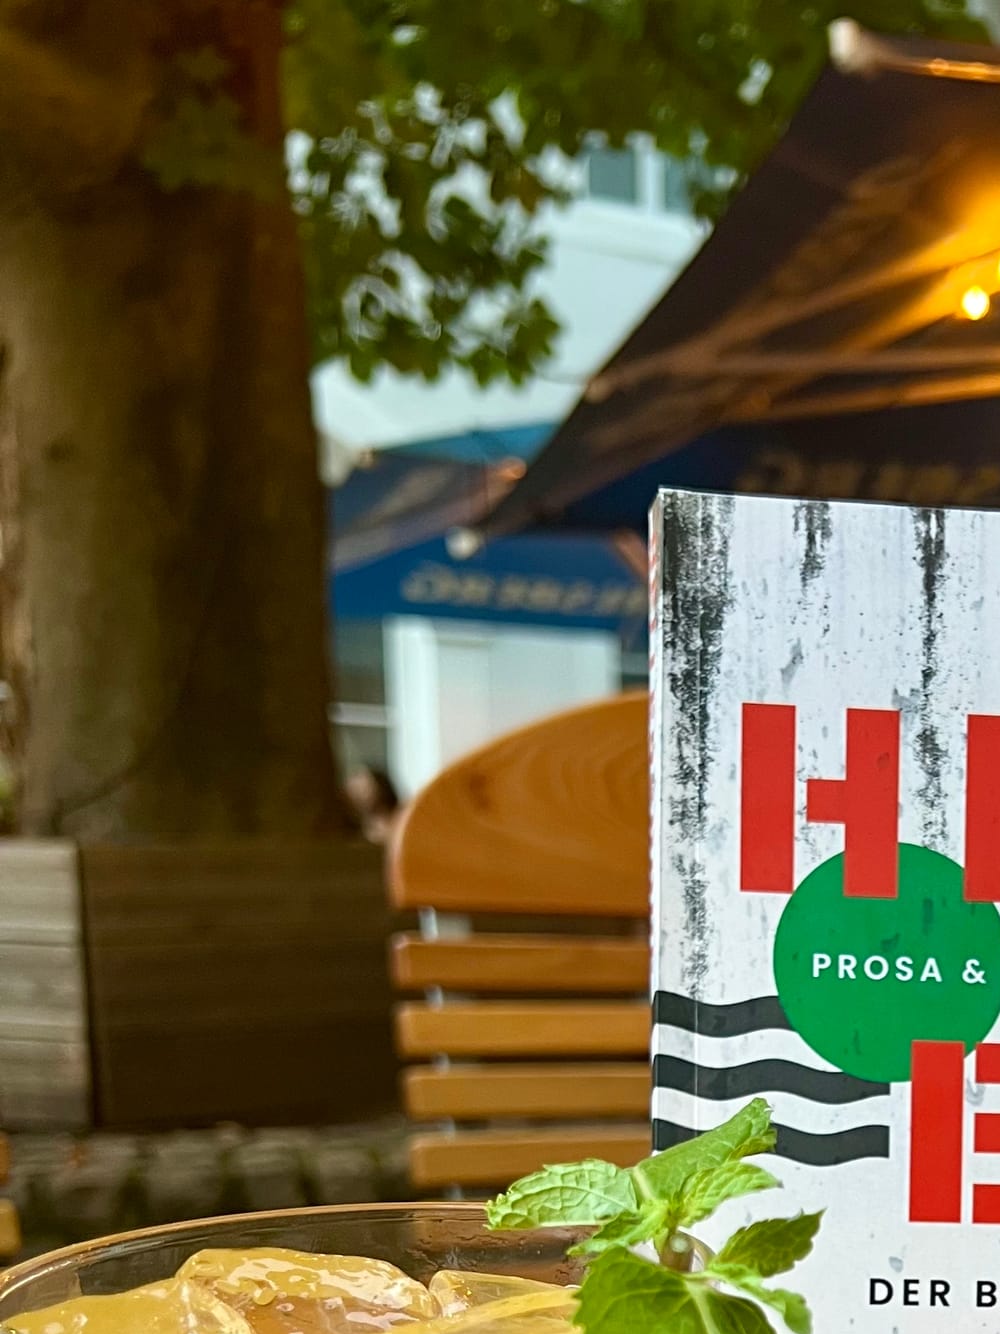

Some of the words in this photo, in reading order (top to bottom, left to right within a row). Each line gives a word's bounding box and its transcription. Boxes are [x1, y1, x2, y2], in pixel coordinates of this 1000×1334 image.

[812, 953, 943, 983] PROSA
[961, 959, 987, 985] &
[869, 1277, 951, 1307] DER
